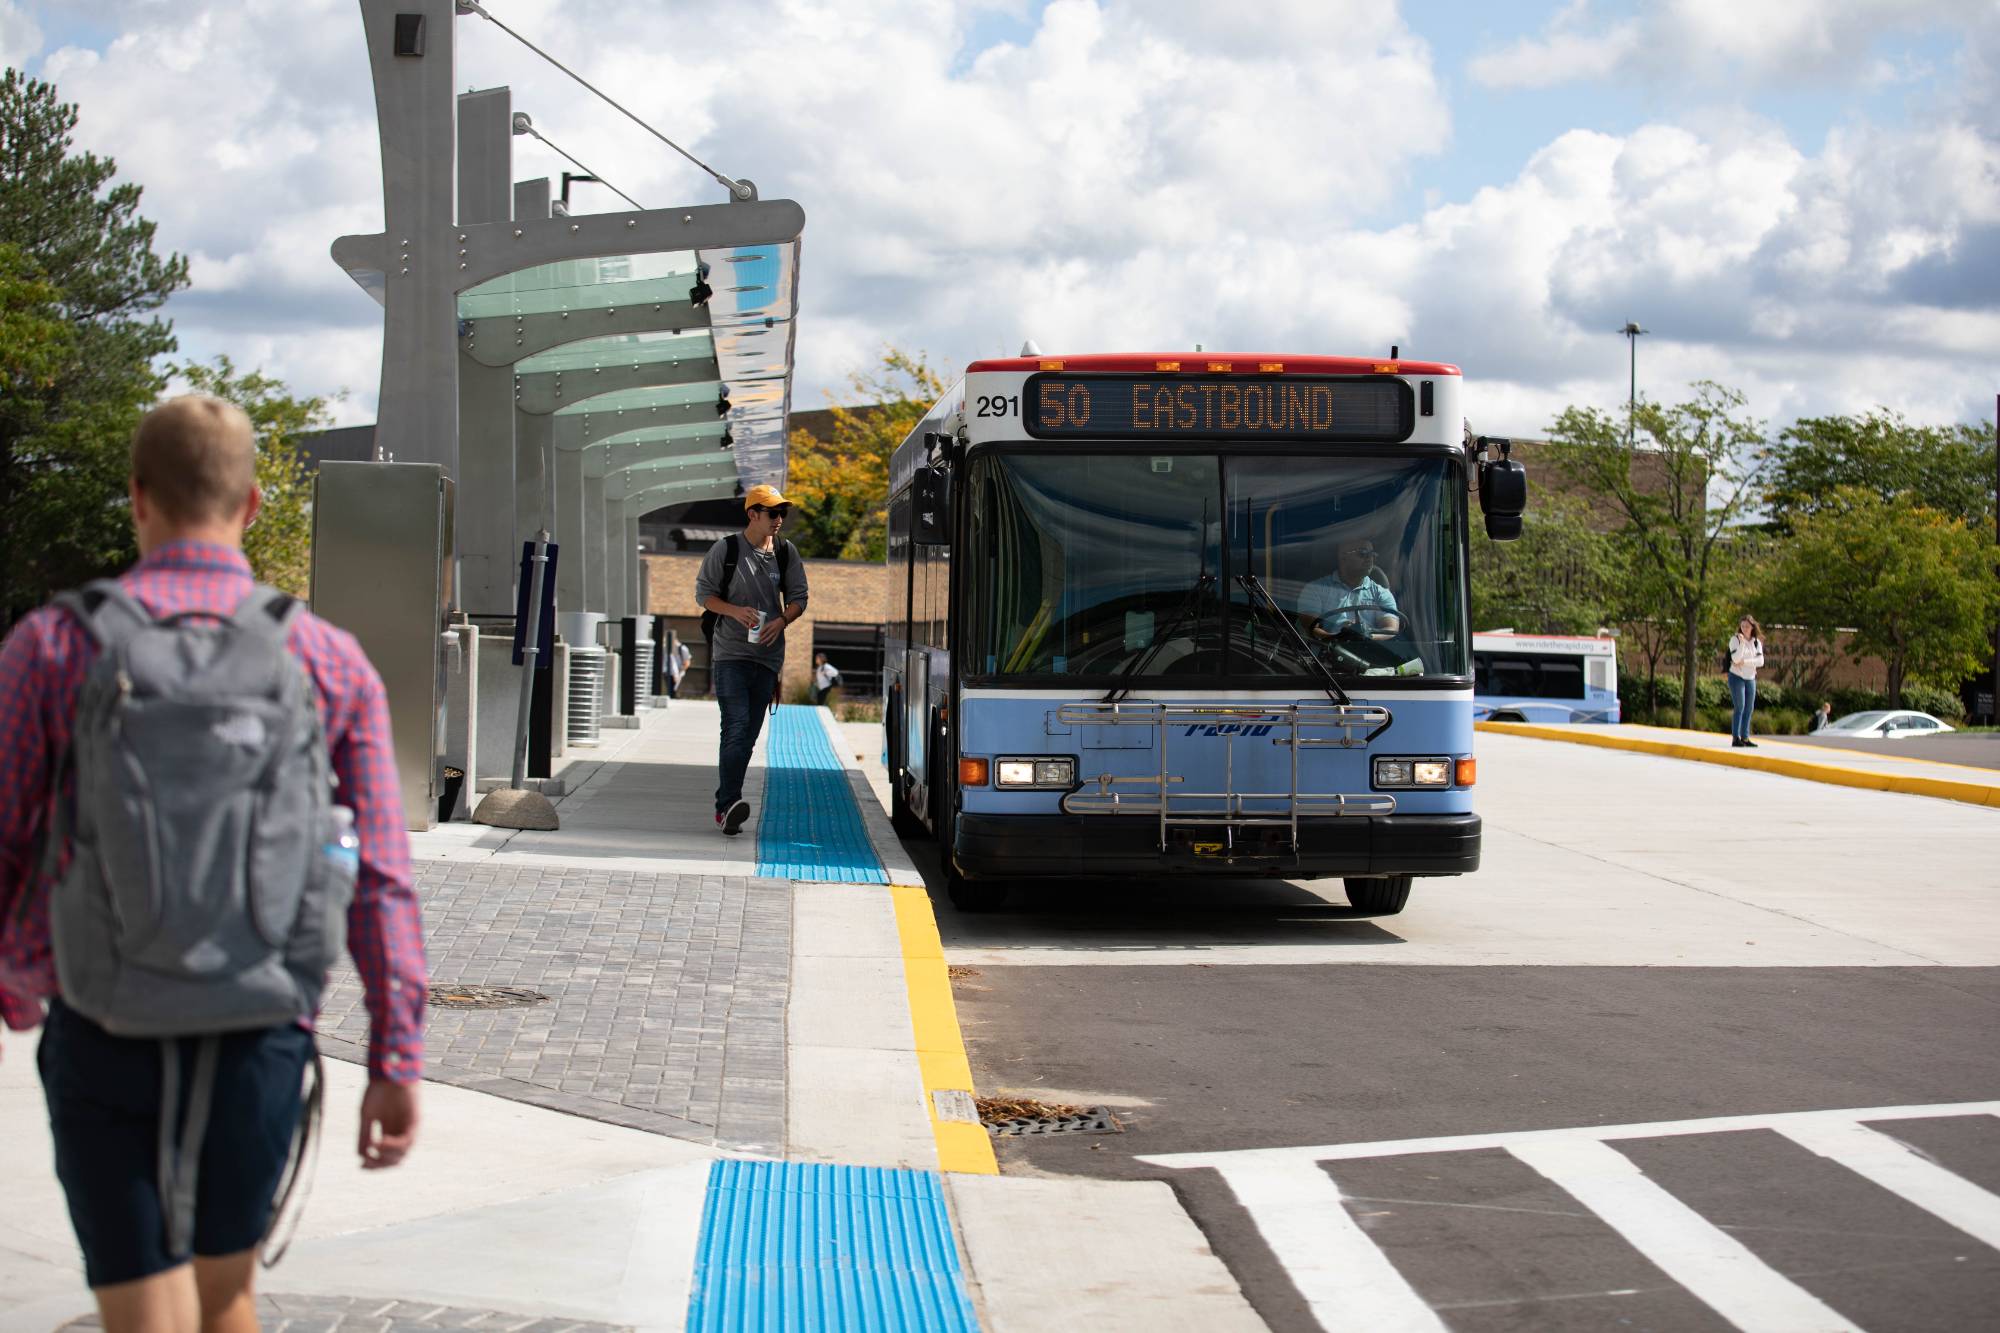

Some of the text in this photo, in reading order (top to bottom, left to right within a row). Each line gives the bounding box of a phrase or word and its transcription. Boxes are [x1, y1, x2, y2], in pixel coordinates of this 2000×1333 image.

[977, 395, 1018, 417] 291
[1041, 383, 1332, 430] 50 EASTBOUND
[1515, 640, 1594, 651] www.ridetherapid.org
